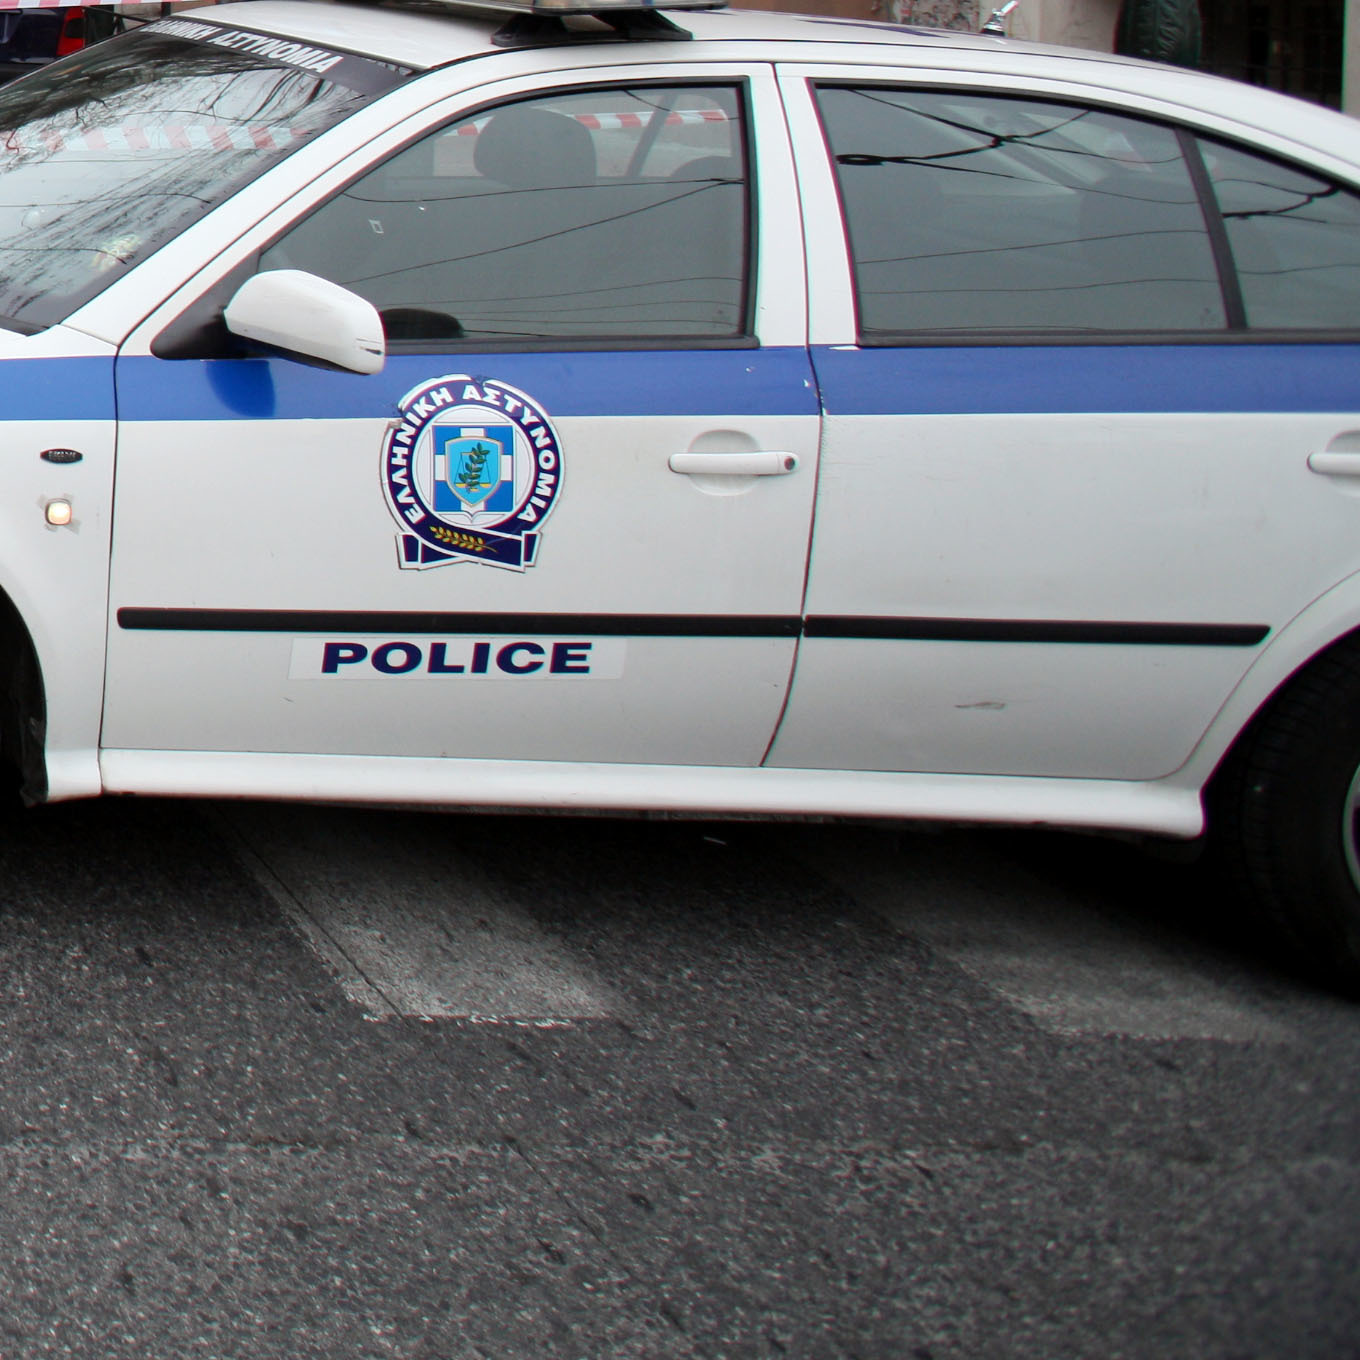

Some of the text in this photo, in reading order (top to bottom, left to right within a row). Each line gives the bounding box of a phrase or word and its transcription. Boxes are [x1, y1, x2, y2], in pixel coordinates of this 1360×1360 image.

[207, 31, 344, 73] ΑΣΤΥΝΟΜΙΑ
[391, 384, 556, 525] ΕΛΛΗΝΙΚΗ ΑΣΤΥΝΟΜΙΑ
[321, 641, 593, 675] POLICE
